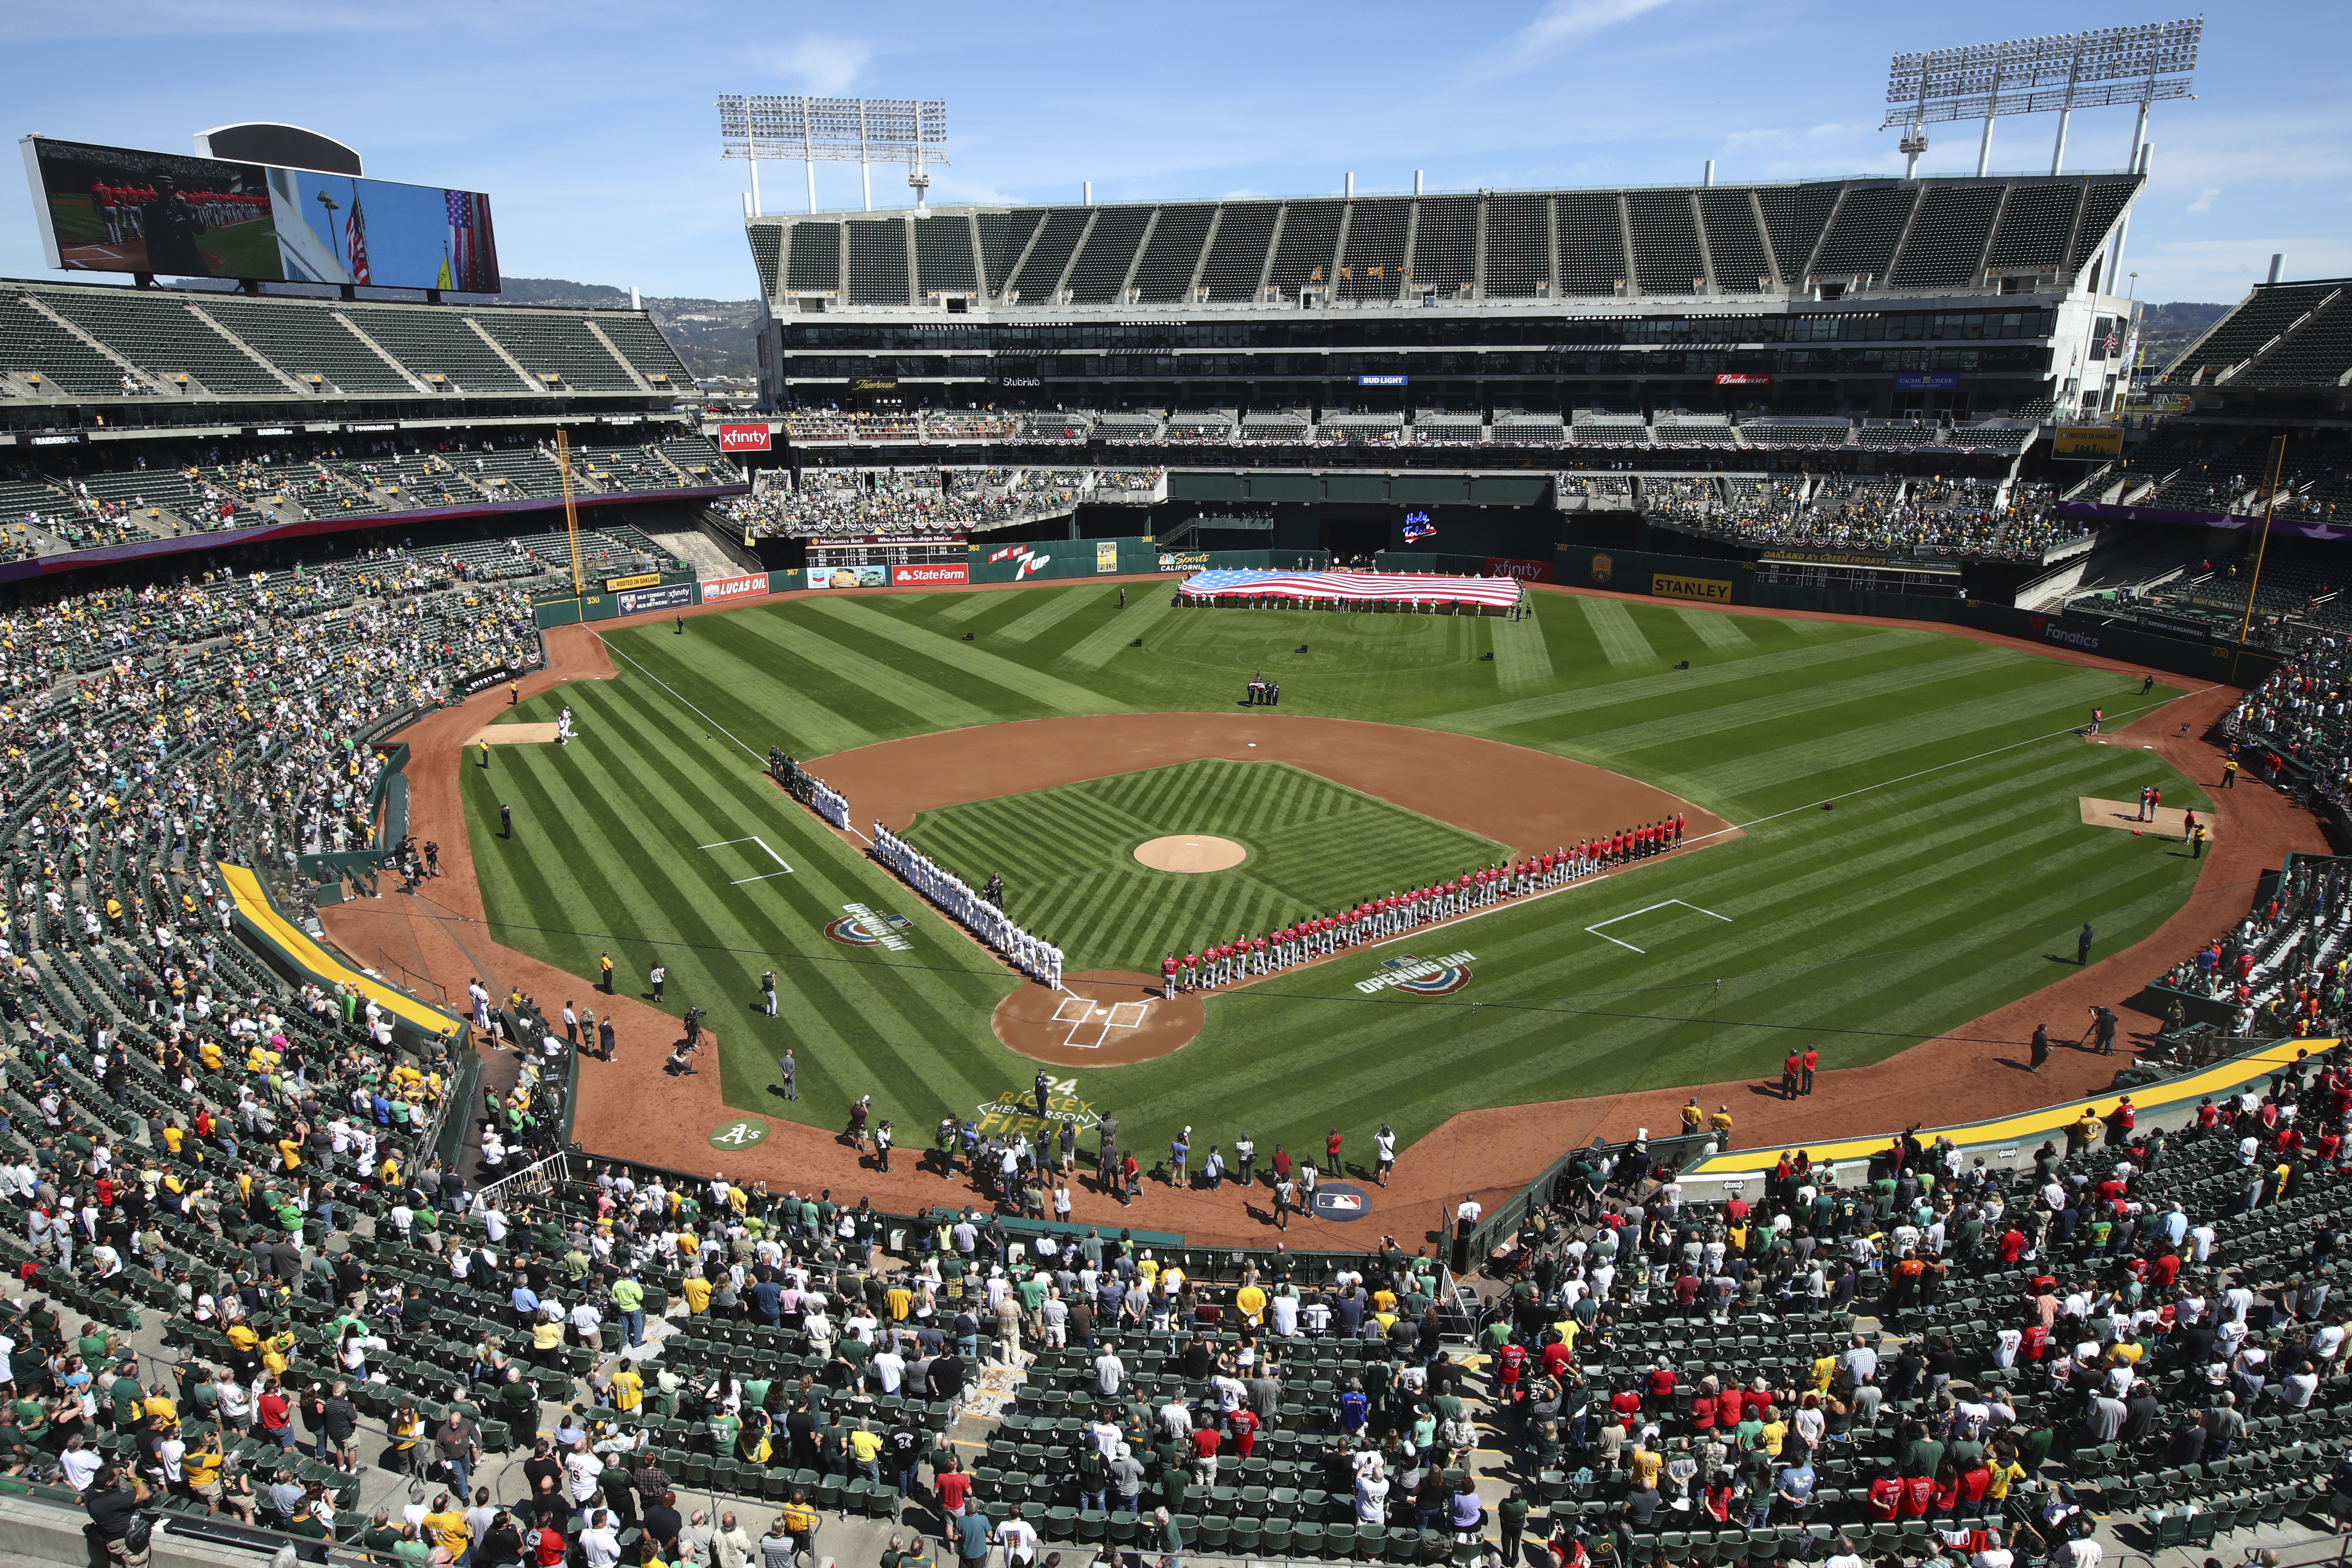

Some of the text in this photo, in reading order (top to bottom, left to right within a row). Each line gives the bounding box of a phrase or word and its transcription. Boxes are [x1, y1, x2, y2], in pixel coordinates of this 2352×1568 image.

[1003, 377, 1040, 386] StubHub
[1718, 374, 1768, 384] Budweiser
[853, 379, 896, 390] Treehouse
[31, 436, 80, 445] #RAIDERSPIX
[723, 430, 767, 446] xfinity
[1406, 511, 1429, 524] Holy
[992, 547, 1023, 561] DO MORE WITH
[1764, 551, 1804, 560] OAKLAND
[1820, 554, 1849, 563] GREEN
[1174, 553, 1210, 566] Sports
[1494, 560, 1542, 580] xfinity
[640, 576, 658, 584] OAKLAND
[720, 578, 766, 595] LUCAS OIL
[1655, 579, 1728, 598] STANLEY
[668, 588, 689, 598] xfinity
[586, 596, 600, 604] 330
[2234, 604, 2255, 613] TERRCE
[2148, 621, 2202, 636] RETURN GREATNESS
[2046, 623, 2098, 648] Fanatics
[372, 729, 384, 741] CREEK
[386, 720, 400, 731] CASINO
[400, 712, 413, 724] RESORT
[842, 903, 915, 951] OPENING DAY
[1354, 949, 1478, 993] OPENING DAY
[998, 1091, 1095, 1112] RICKEY
[712, 1124, 761, 1144] A's
[1845, 1208, 1853, 1216] 16
[1902, 1237, 1914, 1246] 42
[1712, 1252, 1722, 1260] 24
[1016, 1273, 1021, 1281] 8
[1718, 1289, 1731, 1297] 27
[2033, 1337, 2046, 1347] 27
[2230, 1333, 2244, 1341] 27
[2007, 1342, 2012, 1351] 5
[1506, 1358, 1520, 1368] 27
[617, 1385, 628, 1395] 52
[1220, 1384, 1237, 1392] CROSBY
[1225, 1391, 1233, 1400] 7
[1968, 1415, 1983, 1424] 42
[1236, 1424, 1251, 1435] 27
[710, 1430, 729, 1440] 34
[898, 1439, 911, 1449] 24
[570, 1470, 579, 1479] 16
[1995, 1471, 2008, 1482] 21
[1913, 1490, 1929, 1501] 27
[786, 1513, 803, 1522] SECURITY
